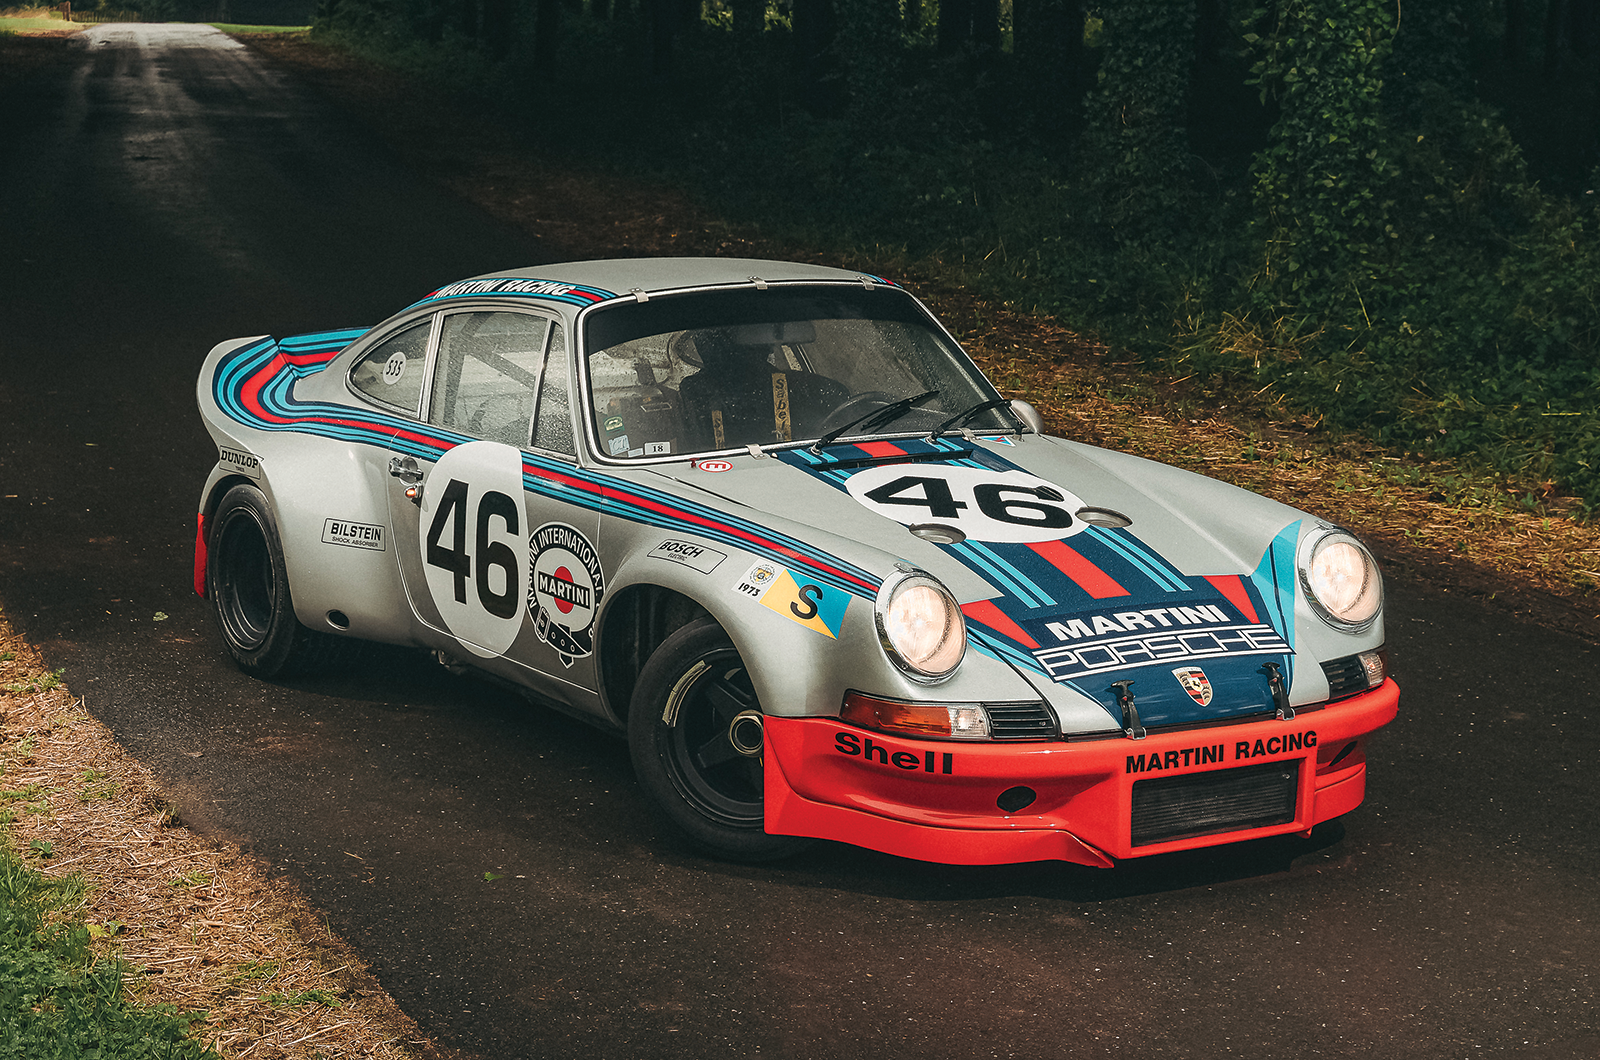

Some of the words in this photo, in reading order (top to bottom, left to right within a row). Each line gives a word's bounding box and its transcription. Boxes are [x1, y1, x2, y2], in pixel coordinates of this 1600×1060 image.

[433, 279, 507, 299] MARTINI
[499, 279, 577, 296] RACING
[386, 360, 403, 376] 535
[221, 450, 259, 469] DUNLOP
[652, 445, 664, 453] 18
[864, 475, 1073, 529] 46
[331, 523, 381, 541] BILSTEIN
[331, 536, 350, 544] SHOCK
[352, 539, 379, 548] ABSORBER
[426, 478, 519, 620] 46
[537, 527, 603, 592] INTERNATIONAL
[658, 541, 704, 558] BOSCH
[539, 574, 589, 607] MARTINI
[738, 582, 761, 597] 1973
[790, 584, 823, 619] S
[1045, 604, 1231, 641] MARTINI
[1036, 629, 1288, 677] PORSCHE
[834, 732, 953, 775] Shell
[1126, 744, 1224, 774] MARTINI
[1235, 730, 1318, 760] RACING
